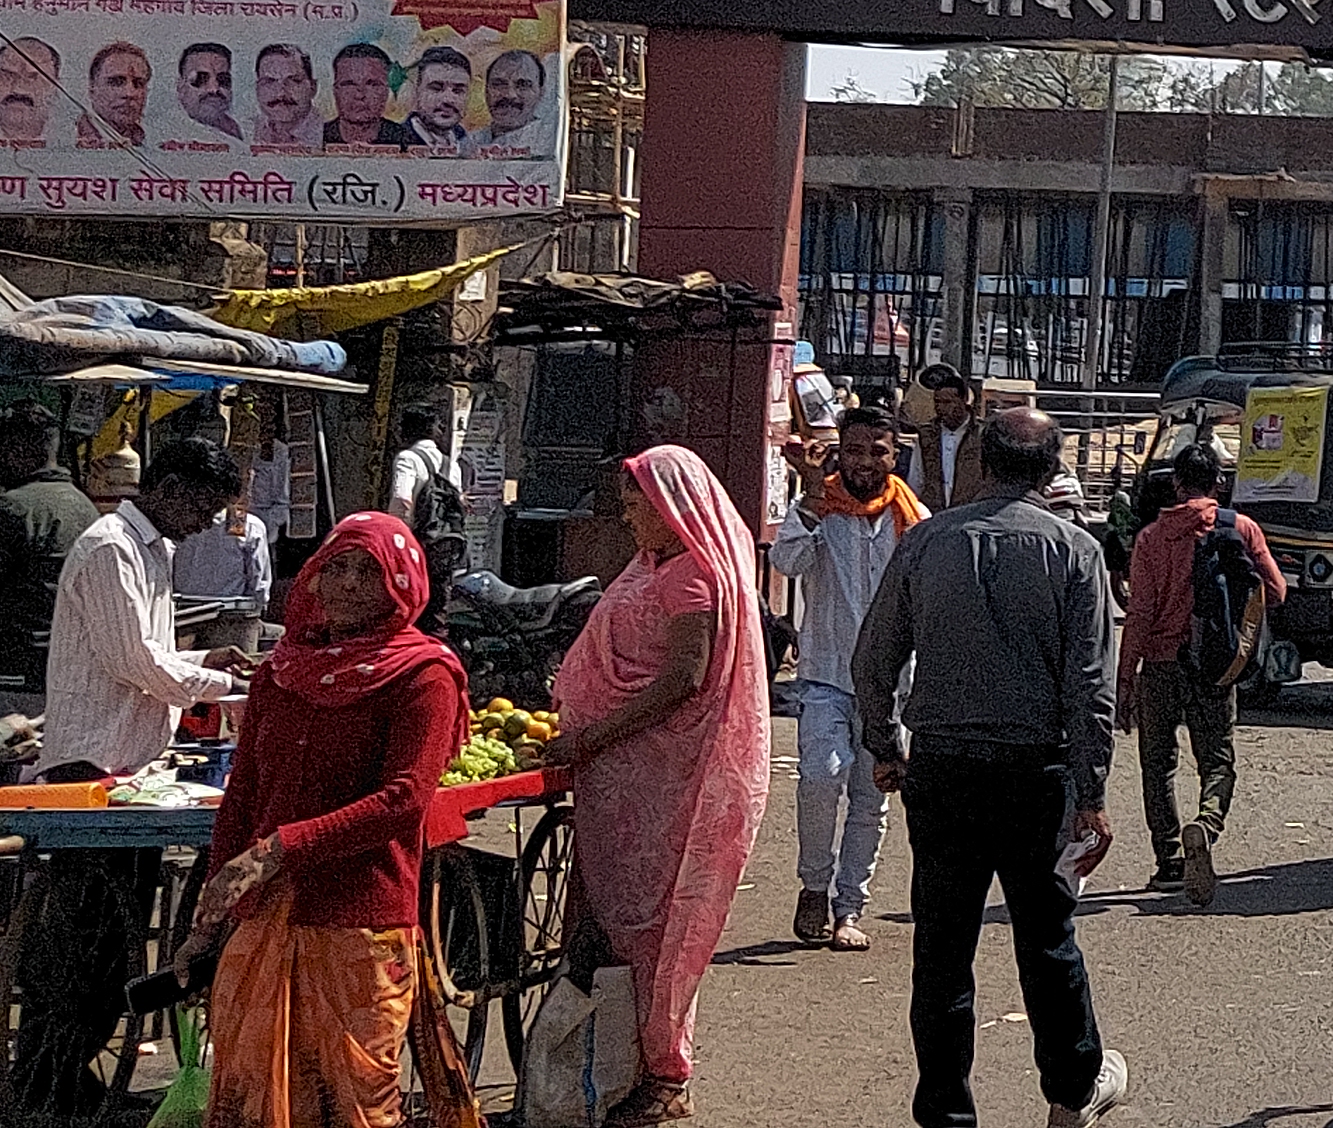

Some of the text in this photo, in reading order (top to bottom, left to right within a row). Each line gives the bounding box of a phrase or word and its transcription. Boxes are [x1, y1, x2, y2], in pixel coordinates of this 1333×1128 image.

[38, 176, 118, 208] सुयश
[200, 171, 297, 203] समिति
[307, 173, 405, 212] (रजि.)
[417, 176, 551, 207] मध्यप्रदेश
